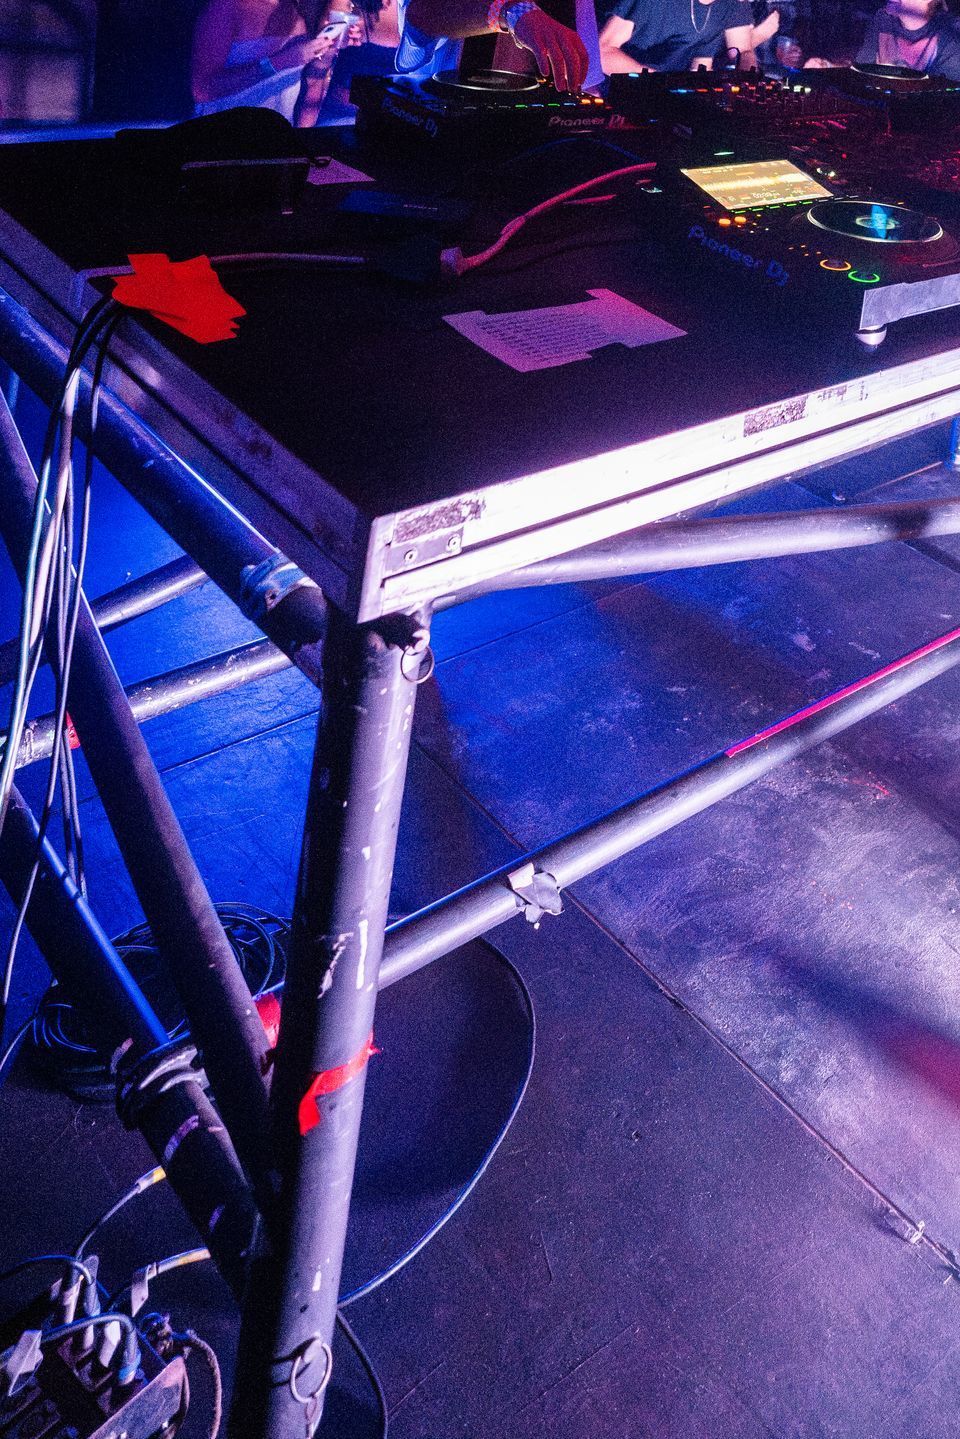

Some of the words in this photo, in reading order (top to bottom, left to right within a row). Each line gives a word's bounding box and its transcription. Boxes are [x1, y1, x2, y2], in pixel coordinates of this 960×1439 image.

[548, 115, 604, 127] Pioneer
[687, 224, 761, 269] Pioneer
[766, 258, 789, 287] DJ
